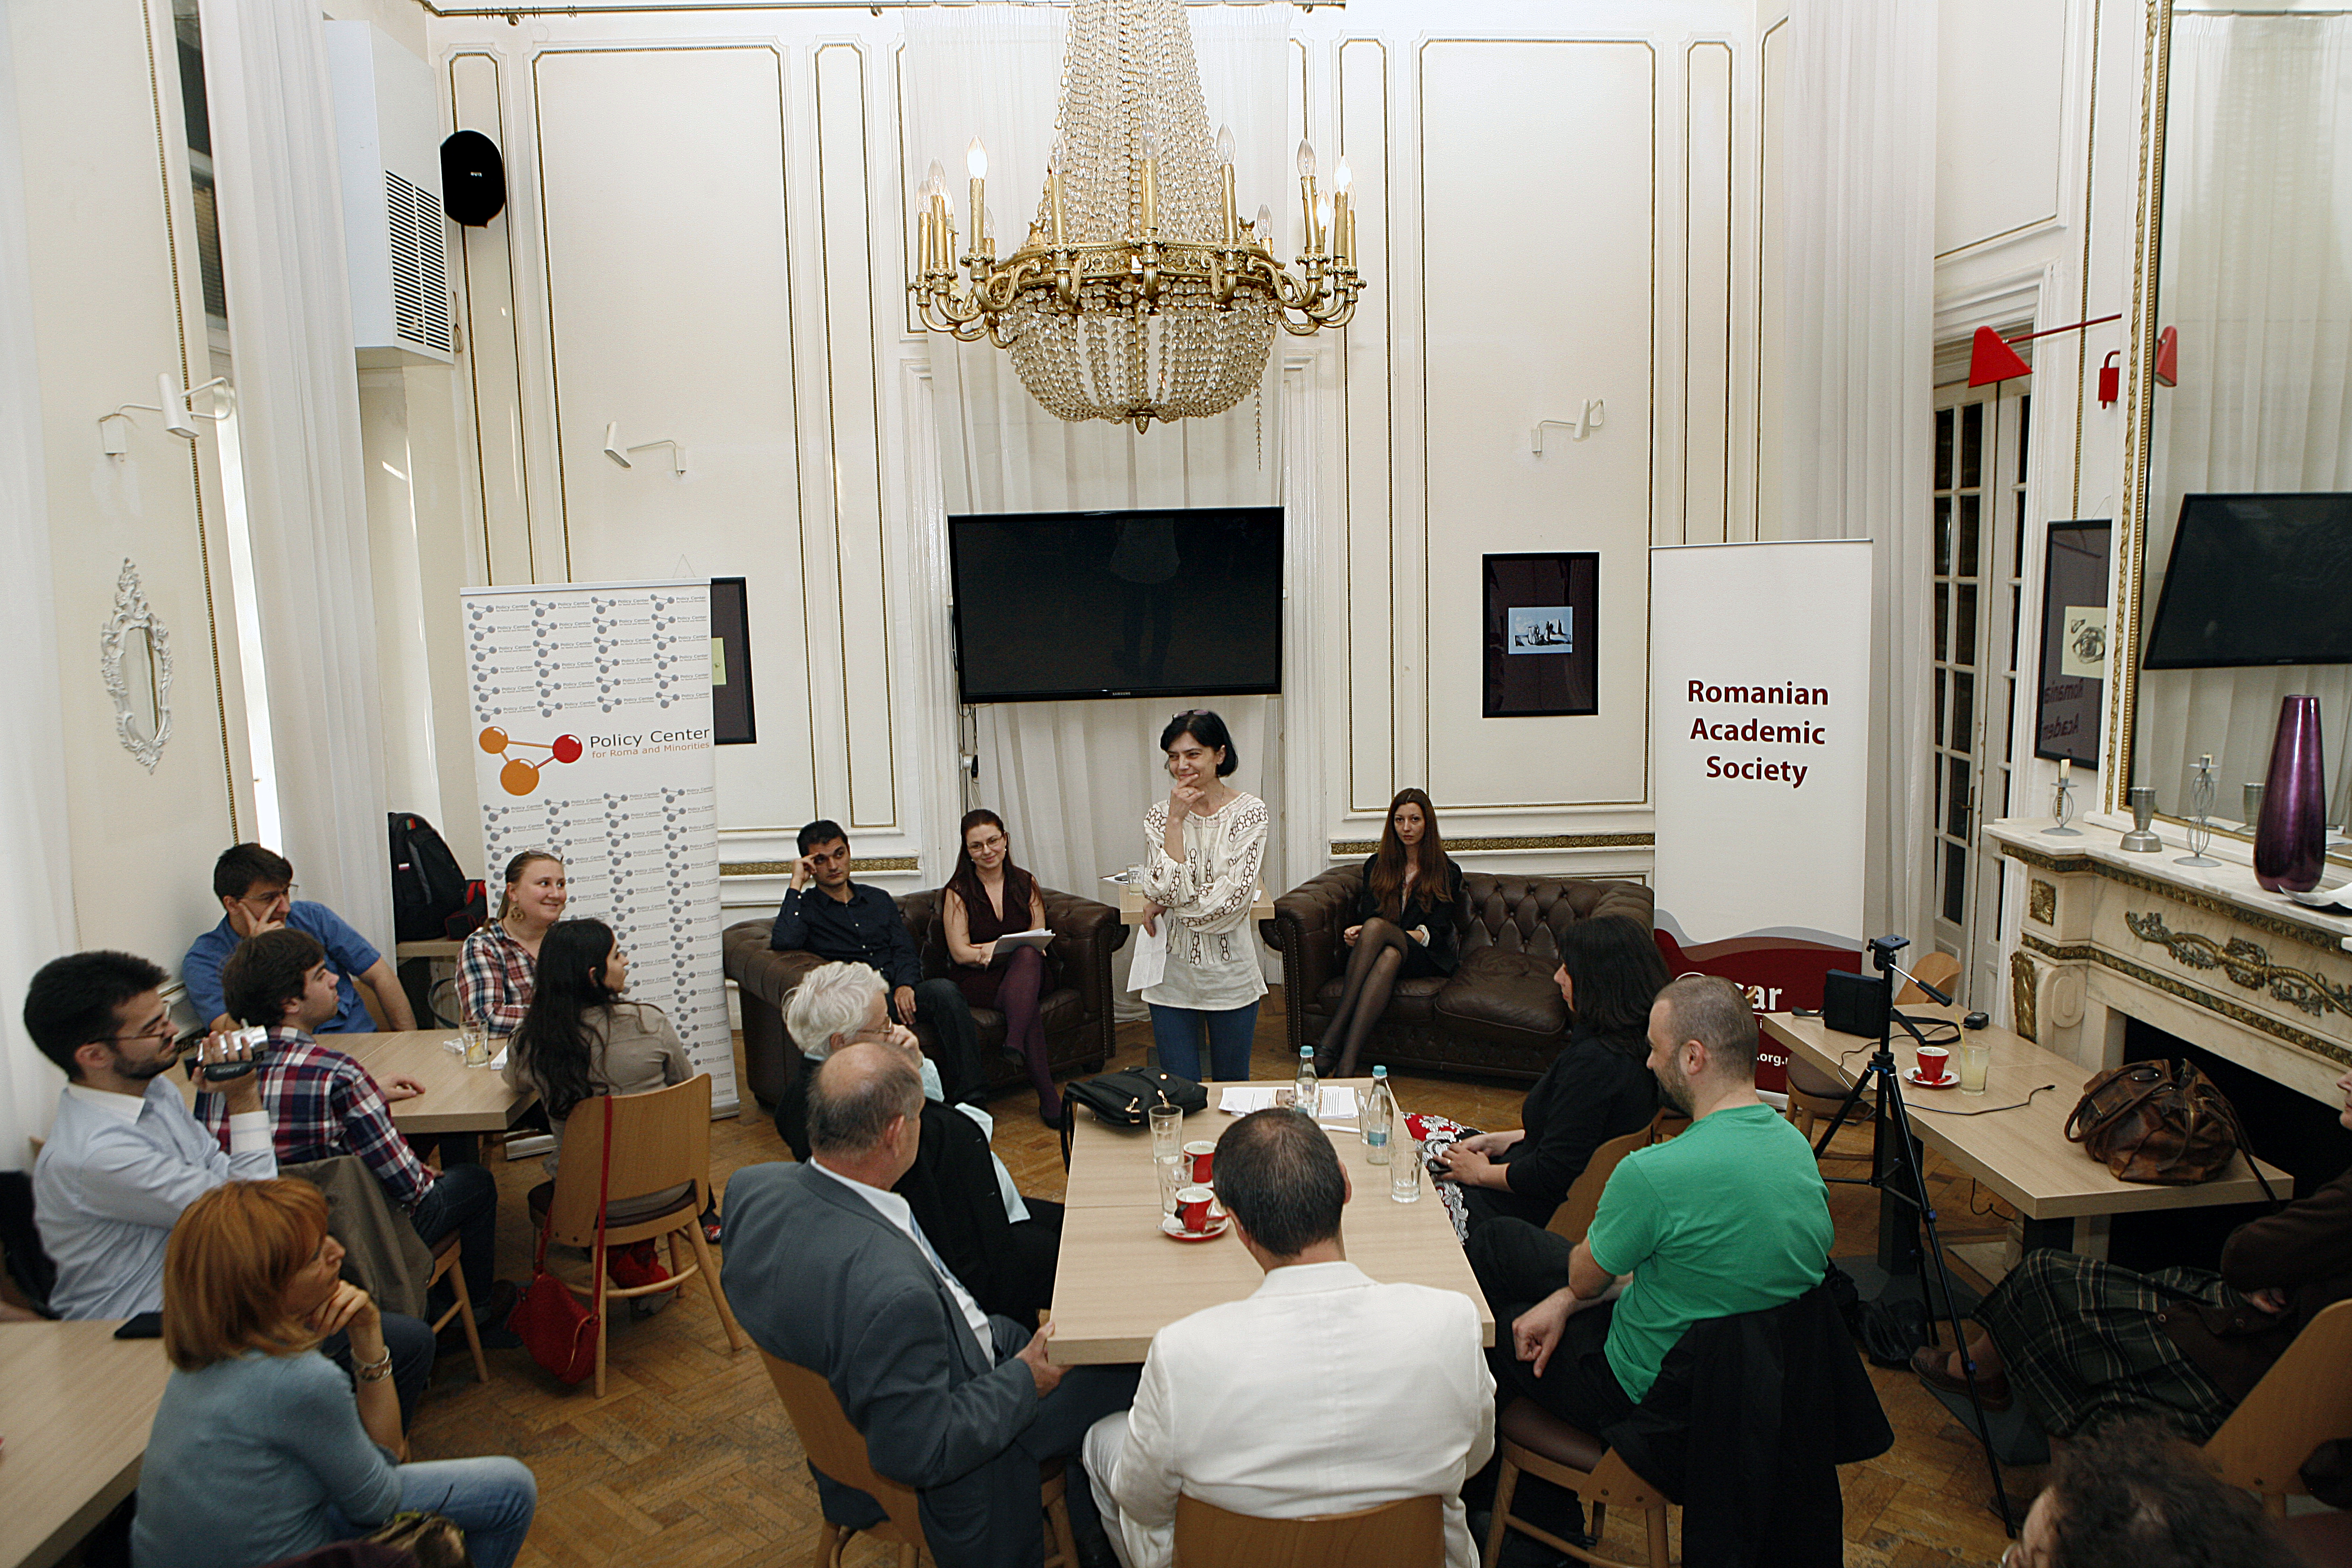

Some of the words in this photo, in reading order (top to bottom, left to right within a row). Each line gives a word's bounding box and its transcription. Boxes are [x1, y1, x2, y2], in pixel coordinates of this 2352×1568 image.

[1688, 680, 1828, 705] Romanian
[590, 734, 643, 748] Policy
[650, 729, 710, 743] Center
[1690, 718, 1825, 745] Academic
[610, 748, 639, 757] Roma
[642, 745, 661, 754] and
[664, 741, 710, 752] Minorities
[1706, 755, 1808, 789] Society
[1734, 983, 1782, 1011] ar
